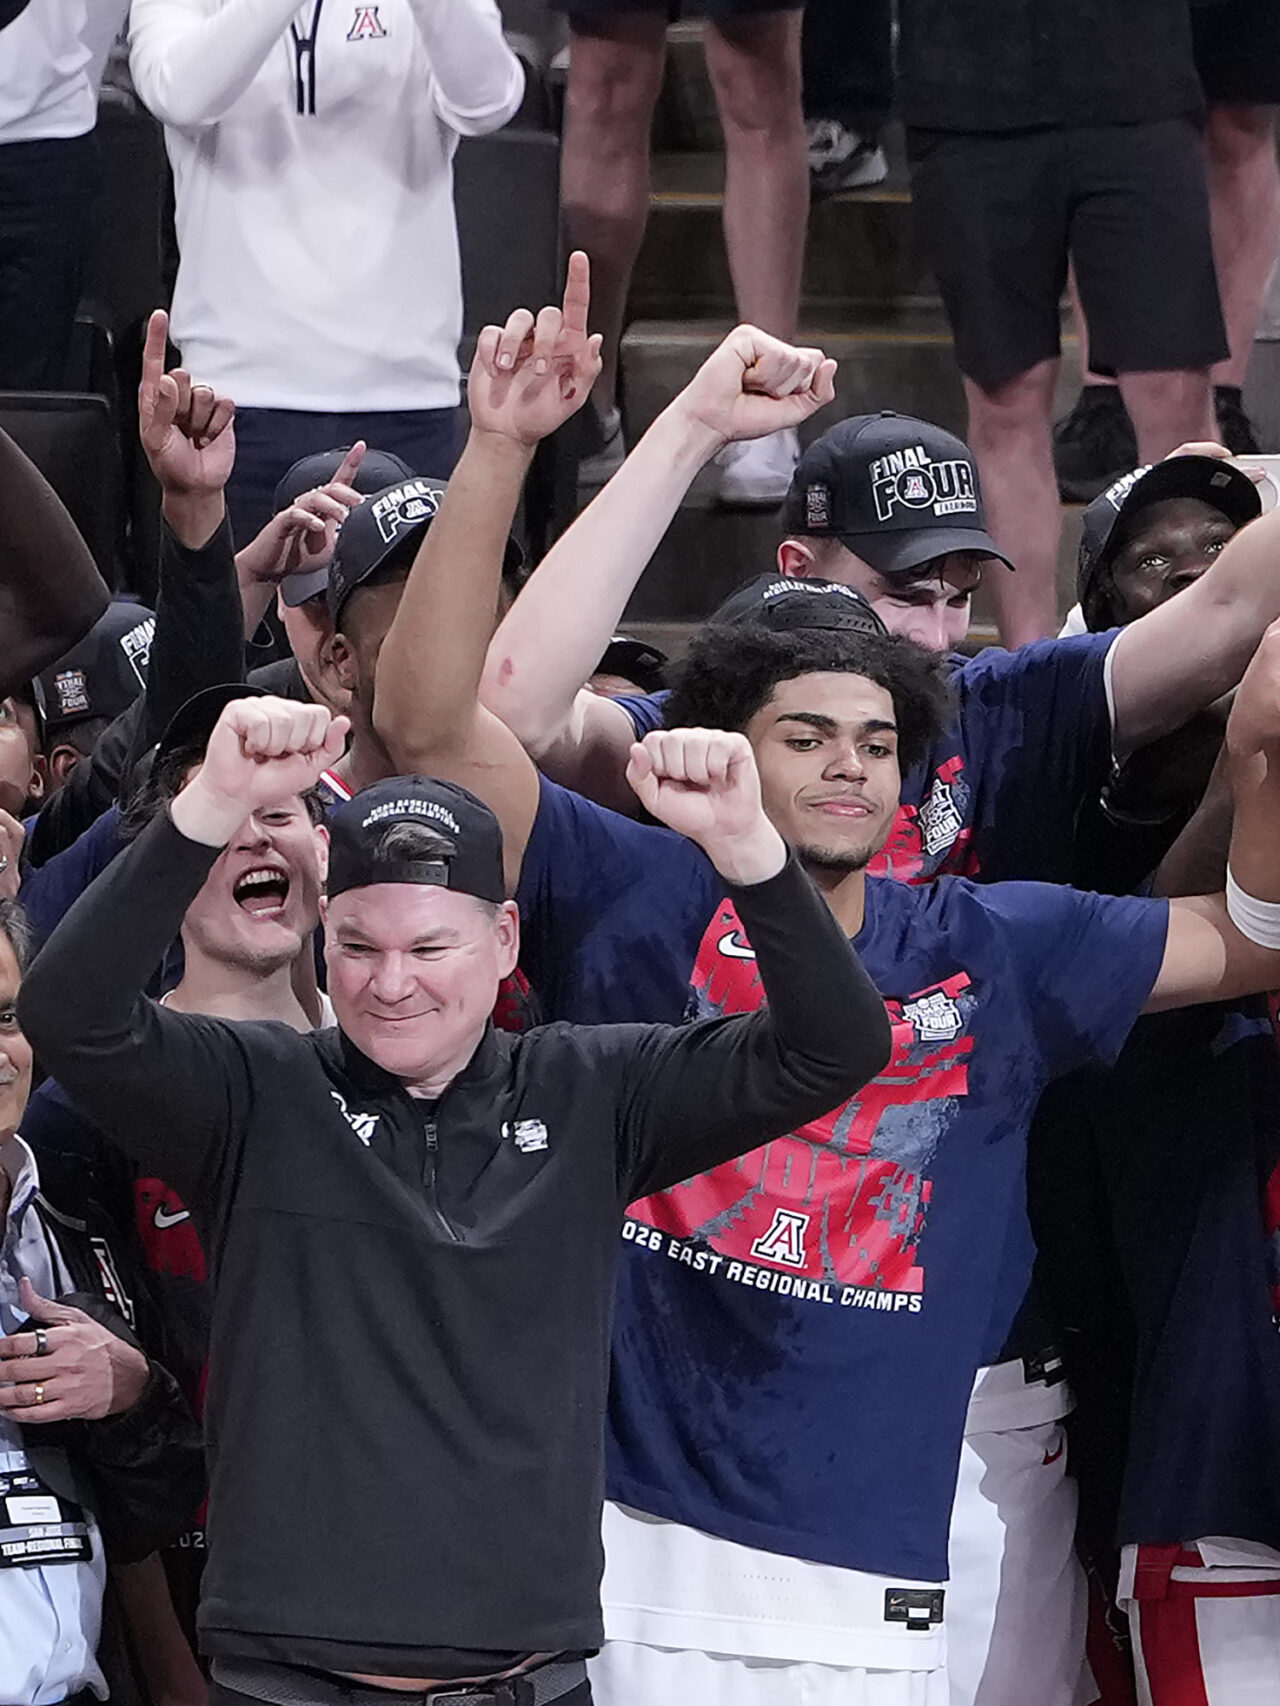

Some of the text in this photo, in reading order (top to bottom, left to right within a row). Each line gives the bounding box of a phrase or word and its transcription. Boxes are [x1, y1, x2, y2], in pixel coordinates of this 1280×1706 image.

[346, 6, 386, 42] A
[871, 446, 931, 482] FINAL
[371, 481, 430, 519] FINAL
[873, 460, 976, 521] FOUR
[925, 815, 960, 844] FOUR
[921, 1014, 957, 1029] FOUR
[750, 1207, 811, 1269] A
[621, 1221, 923, 1314] 026 EAST REGIONAL CHAMPS
